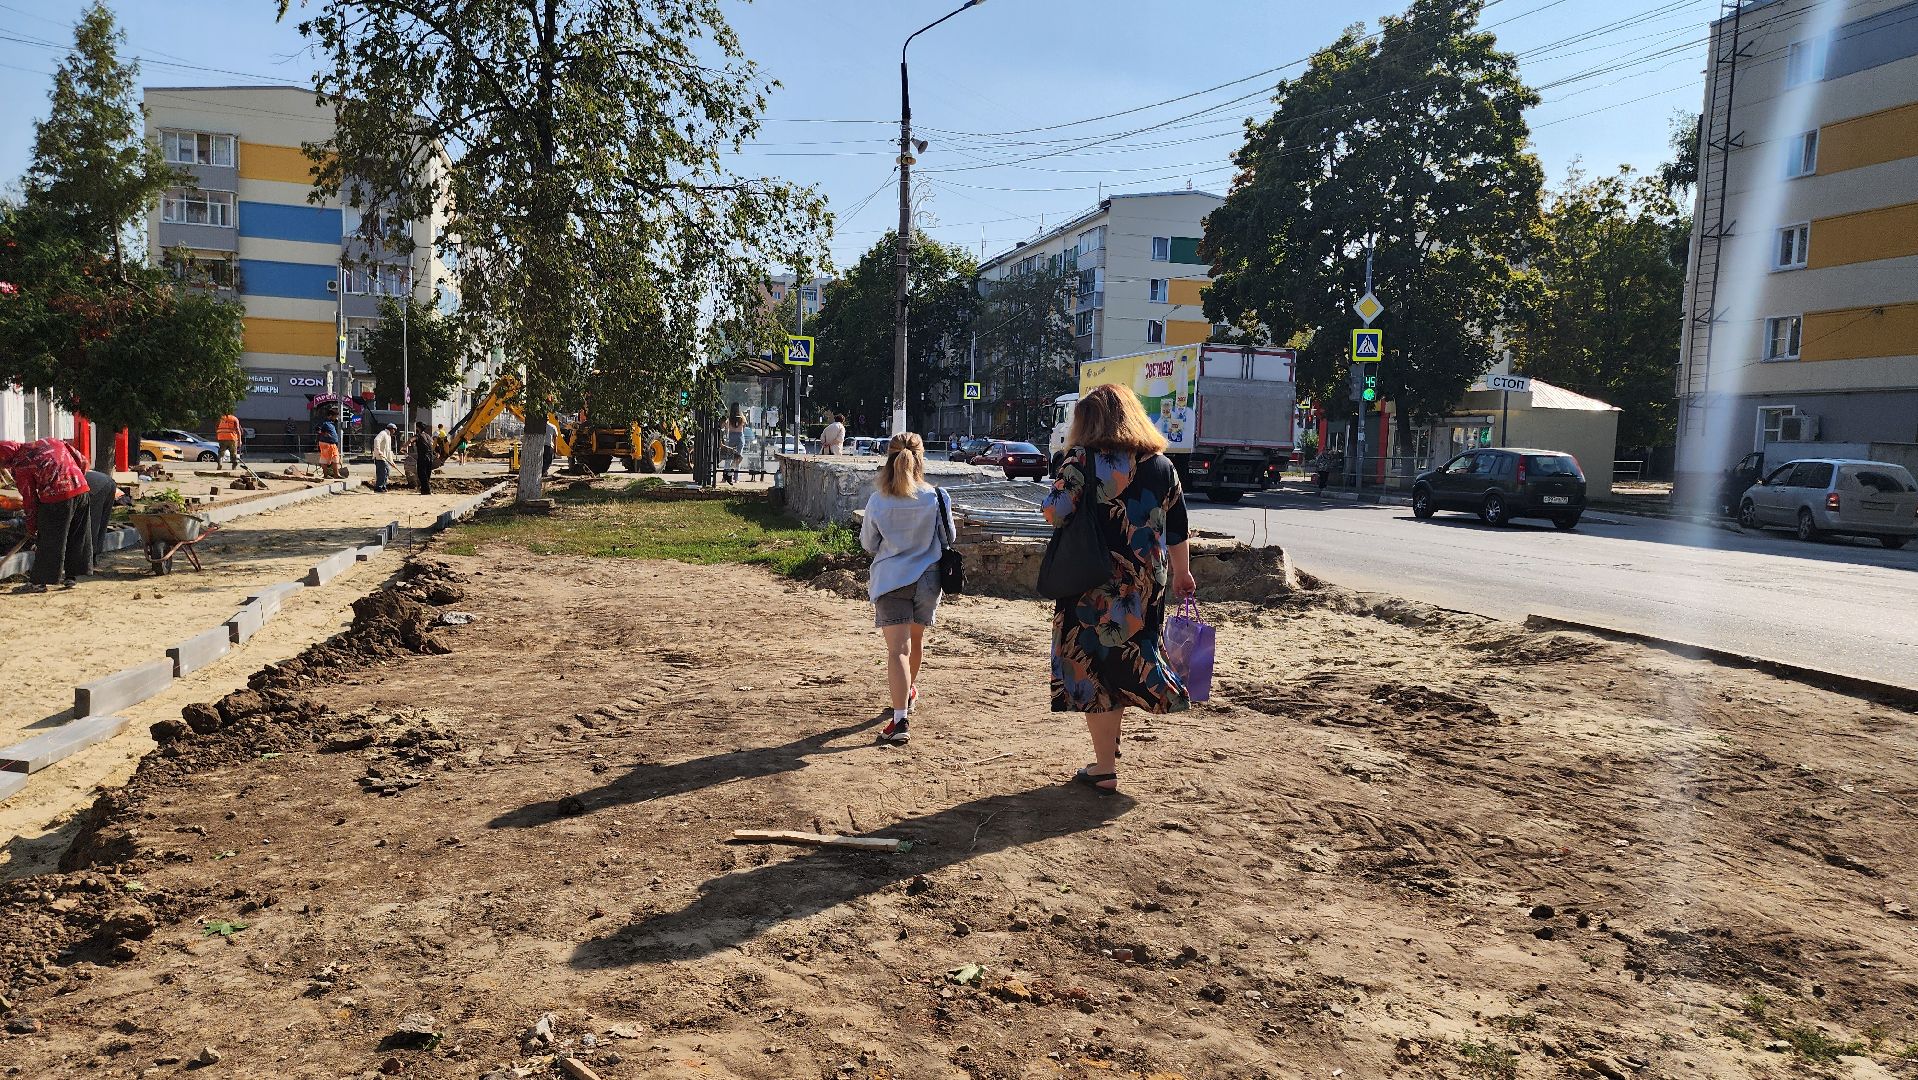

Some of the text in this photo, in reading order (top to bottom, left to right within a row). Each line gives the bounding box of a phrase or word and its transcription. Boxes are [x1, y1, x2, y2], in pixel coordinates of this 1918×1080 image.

[289, 377, 324, 387] OZON
[1365, 376, 1376, 388] 45
[1493, 377, 1525, 389] СТОП
